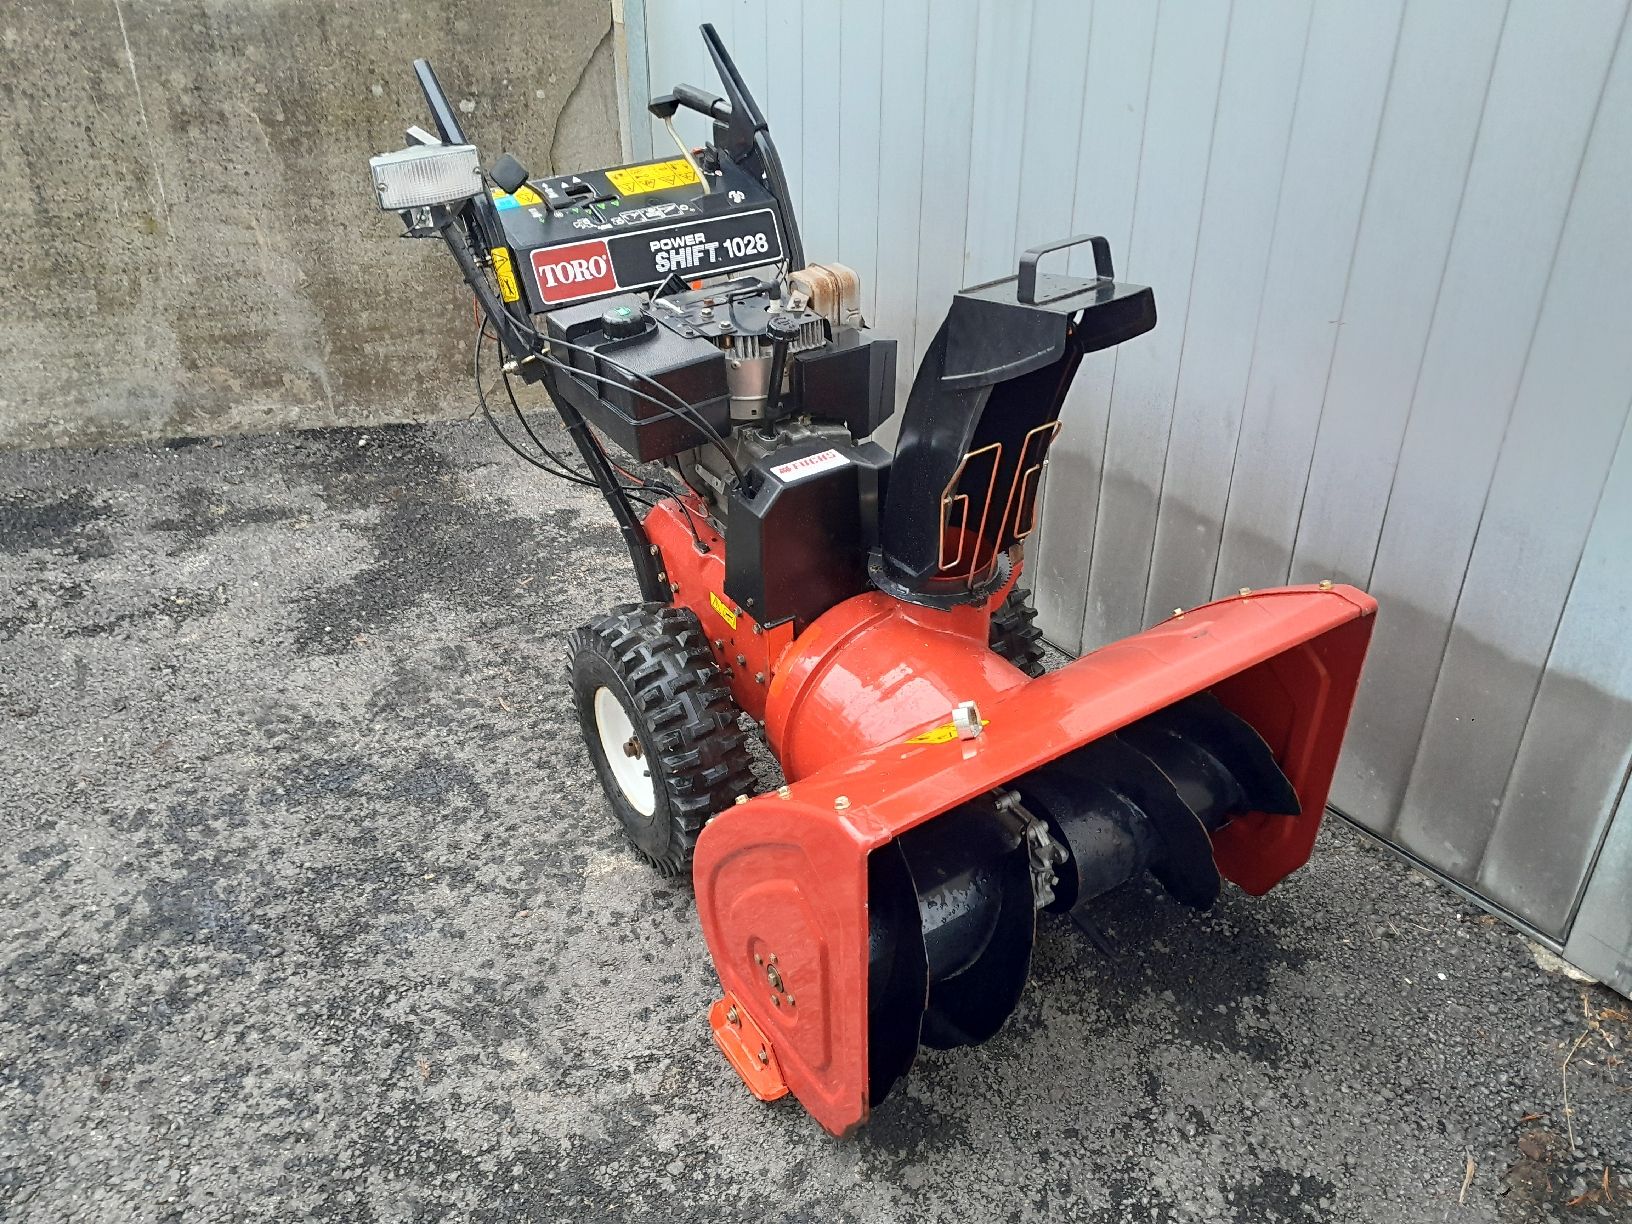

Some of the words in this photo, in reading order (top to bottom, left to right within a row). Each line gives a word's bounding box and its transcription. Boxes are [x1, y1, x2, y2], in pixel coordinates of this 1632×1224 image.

[649, 232, 706, 252] POWER
[655, 242, 719, 273] SHIFT
[723, 232, 769, 258] 1028
[538, 255, 607, 288] TORO
